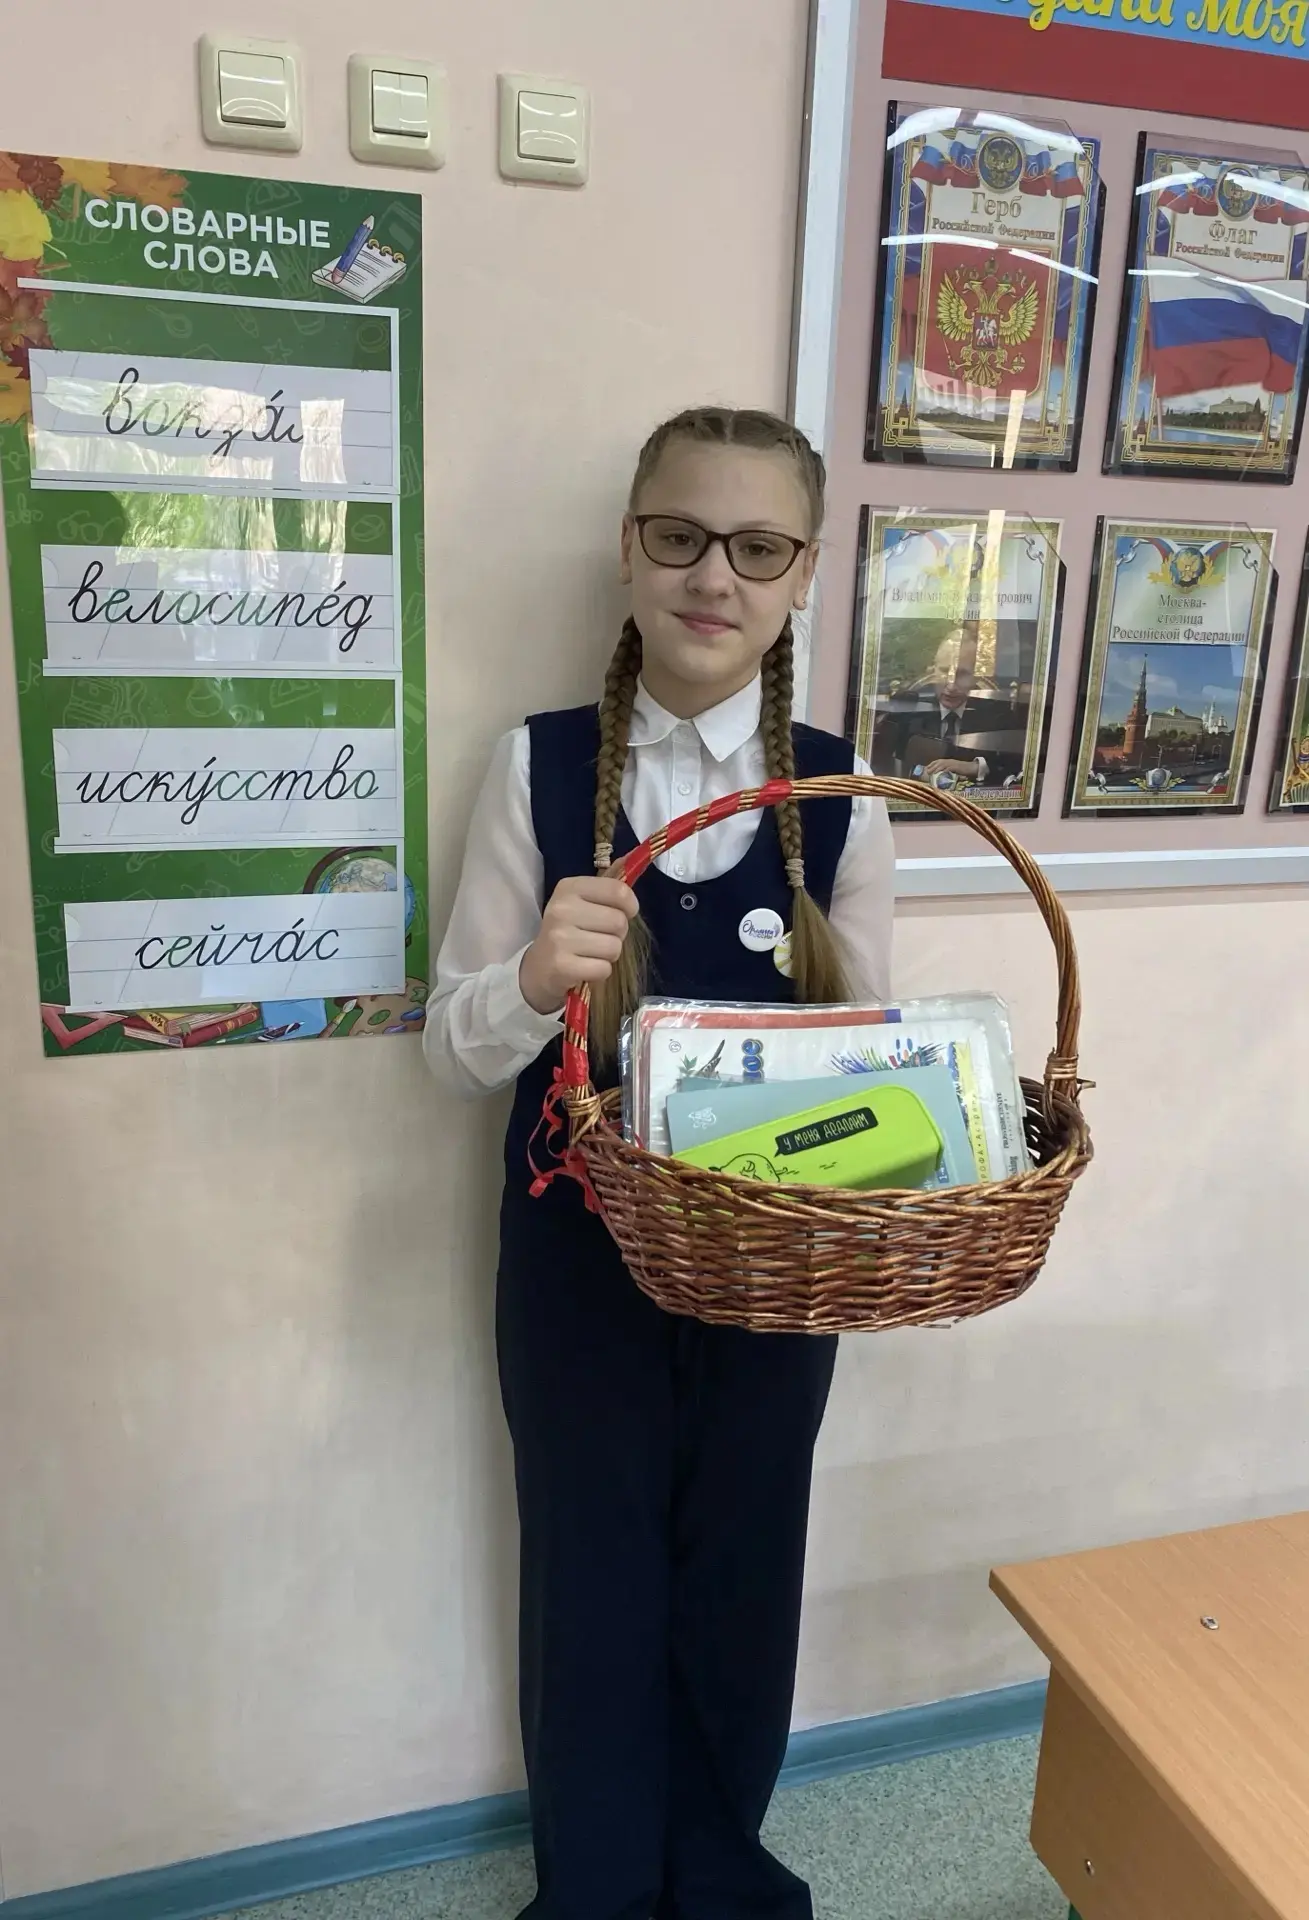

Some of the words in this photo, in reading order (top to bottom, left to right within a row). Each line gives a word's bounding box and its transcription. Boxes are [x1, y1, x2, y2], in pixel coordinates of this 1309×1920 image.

[971, 191, 1023, 222] Герб
[84, 198, 331, 249] СЛОВАРНЫЕ
[932, 217, 995, 235] Российской
[998, 223, 1056, 241] Федерации
[1208, 220, 1258, 245] Флаг
[143, 240, 279, 279] СЛОВА
[1175, 241, 1231, 257] Российской
[1234, 247, 1285, 263] Федерации
[1159, 594, 1207, 608] Москва-
[1157, 614, 1203, 625] столица
[1112, 625, 1180, 640] Российской
[1183, 628, 1245, 644] Федерации
[783, 1136, 793, 1151] У
[975, 1149, 989, 1184] РОФА
